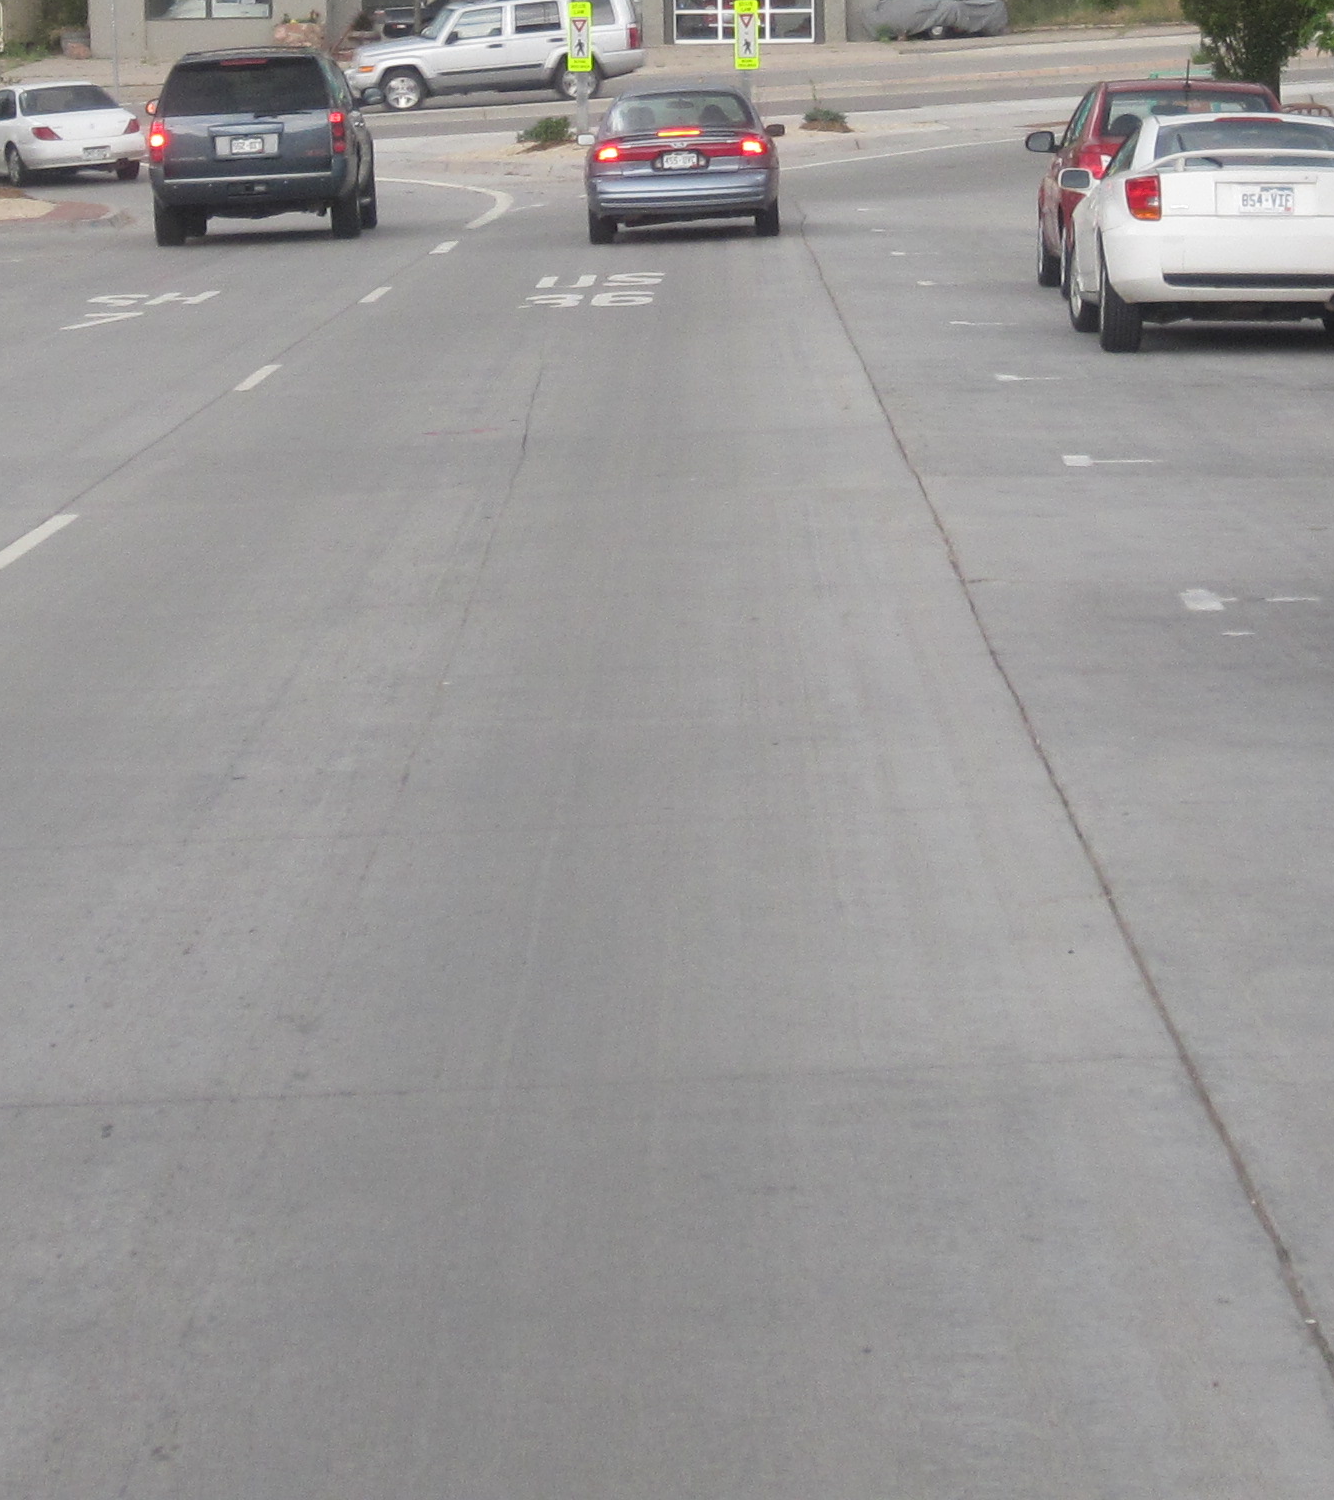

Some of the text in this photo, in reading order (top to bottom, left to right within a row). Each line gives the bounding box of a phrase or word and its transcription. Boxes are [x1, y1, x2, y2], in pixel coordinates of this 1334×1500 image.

[535, 272, 665, 288] US
[87, 291, 221, 306] SH
[519, 291, 655, 308] 36
[59, 311, 144, 330] 7
